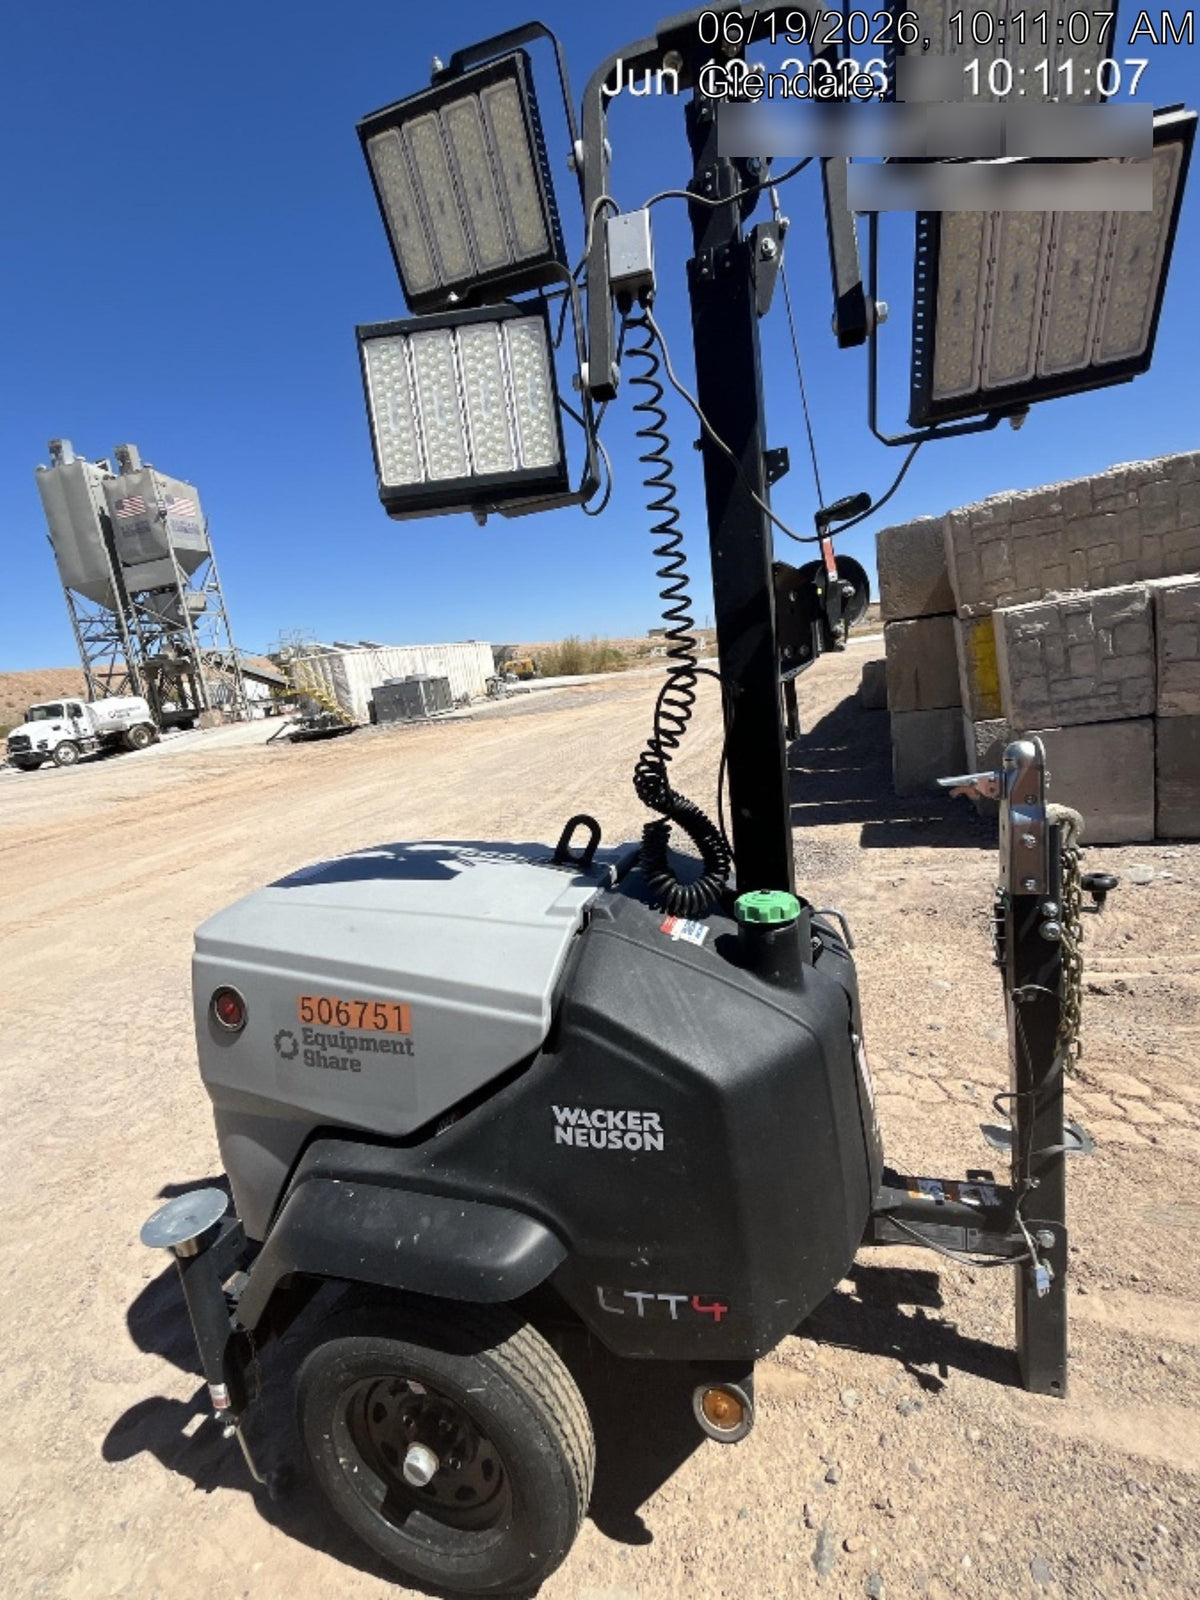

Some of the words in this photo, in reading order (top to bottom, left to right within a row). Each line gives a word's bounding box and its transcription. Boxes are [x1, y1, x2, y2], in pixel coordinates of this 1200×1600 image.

[301, 997, 403, 1031] 506751
[302, 1027, 415, 1056] Equipment
[303, 1049, 361, 1072] Share
[551, 1105, 664, 1131] WACKER
[554, 1125, 664, 1151] NEUSON
[597, 1286, 728, 1321] LTT4
